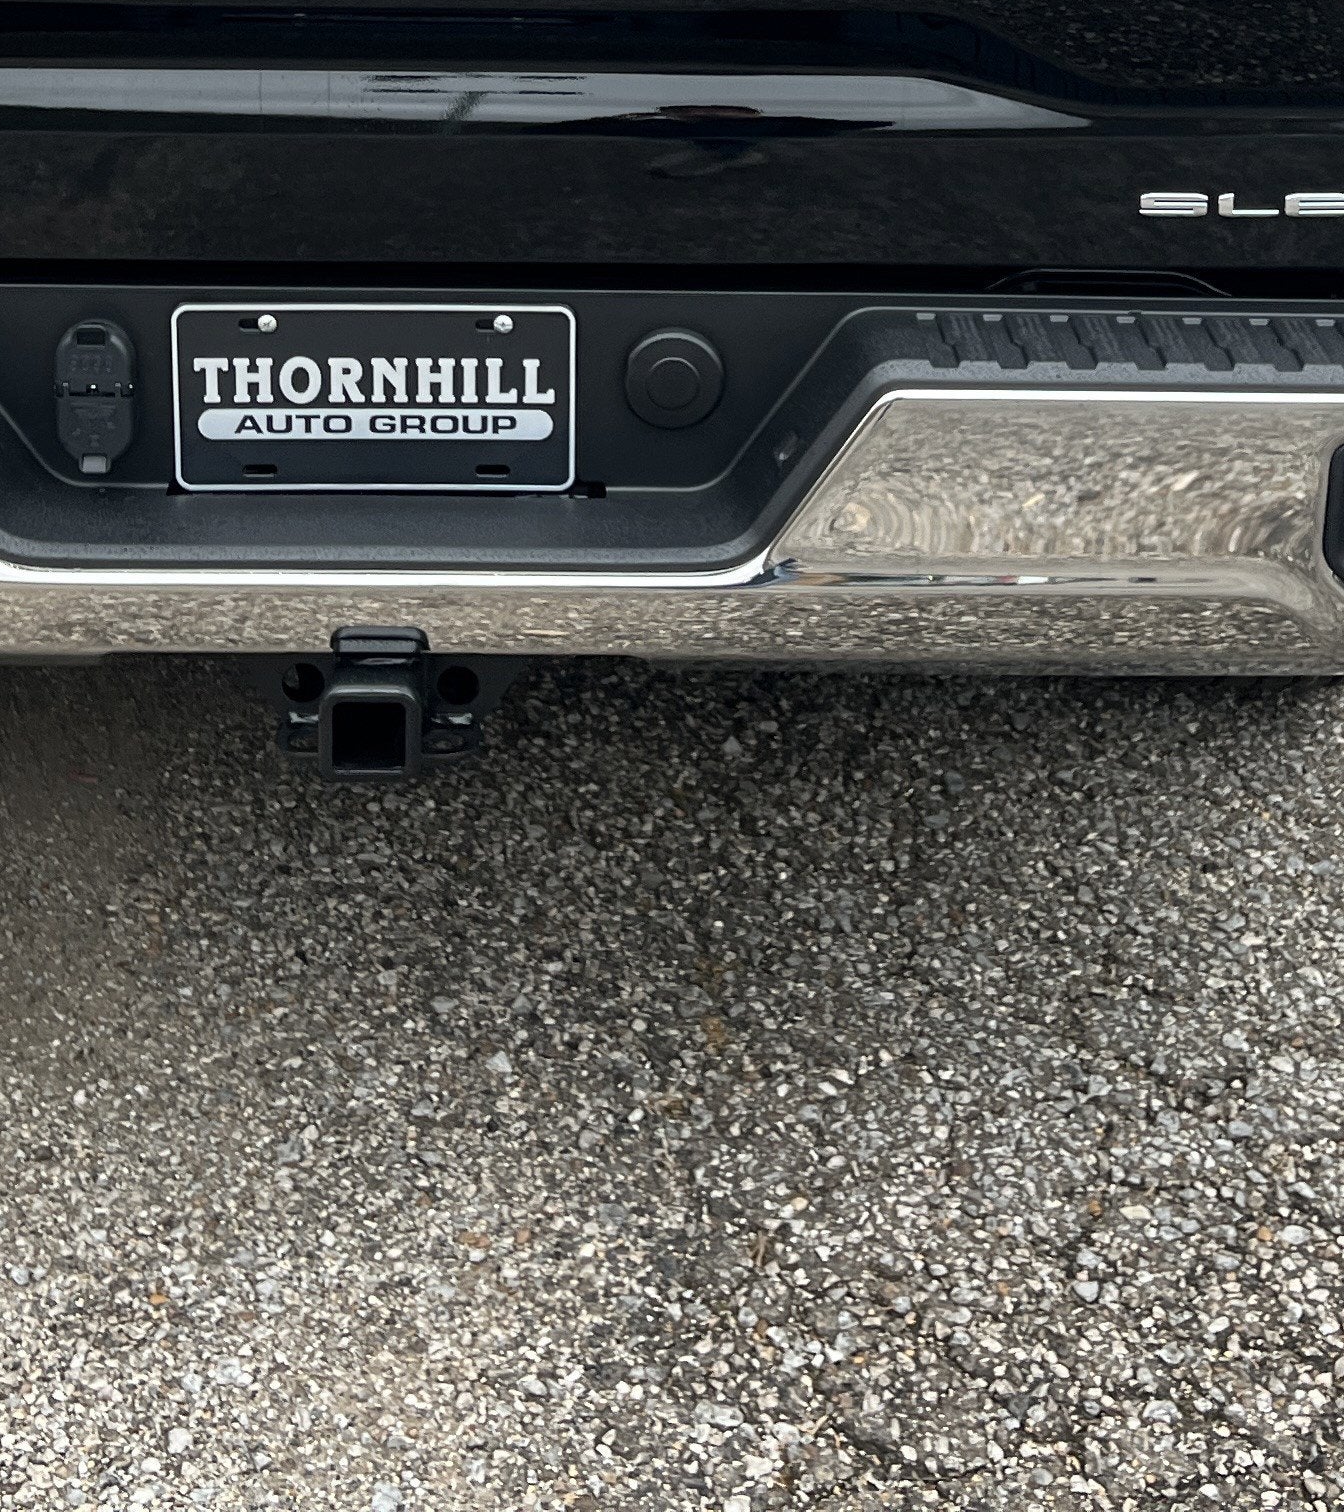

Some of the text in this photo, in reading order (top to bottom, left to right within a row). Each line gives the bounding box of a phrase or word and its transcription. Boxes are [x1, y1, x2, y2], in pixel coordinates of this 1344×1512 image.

[193, 356, 555, 405] THORNHILL
[234, 413, 520, 436] AUTO GROUP
